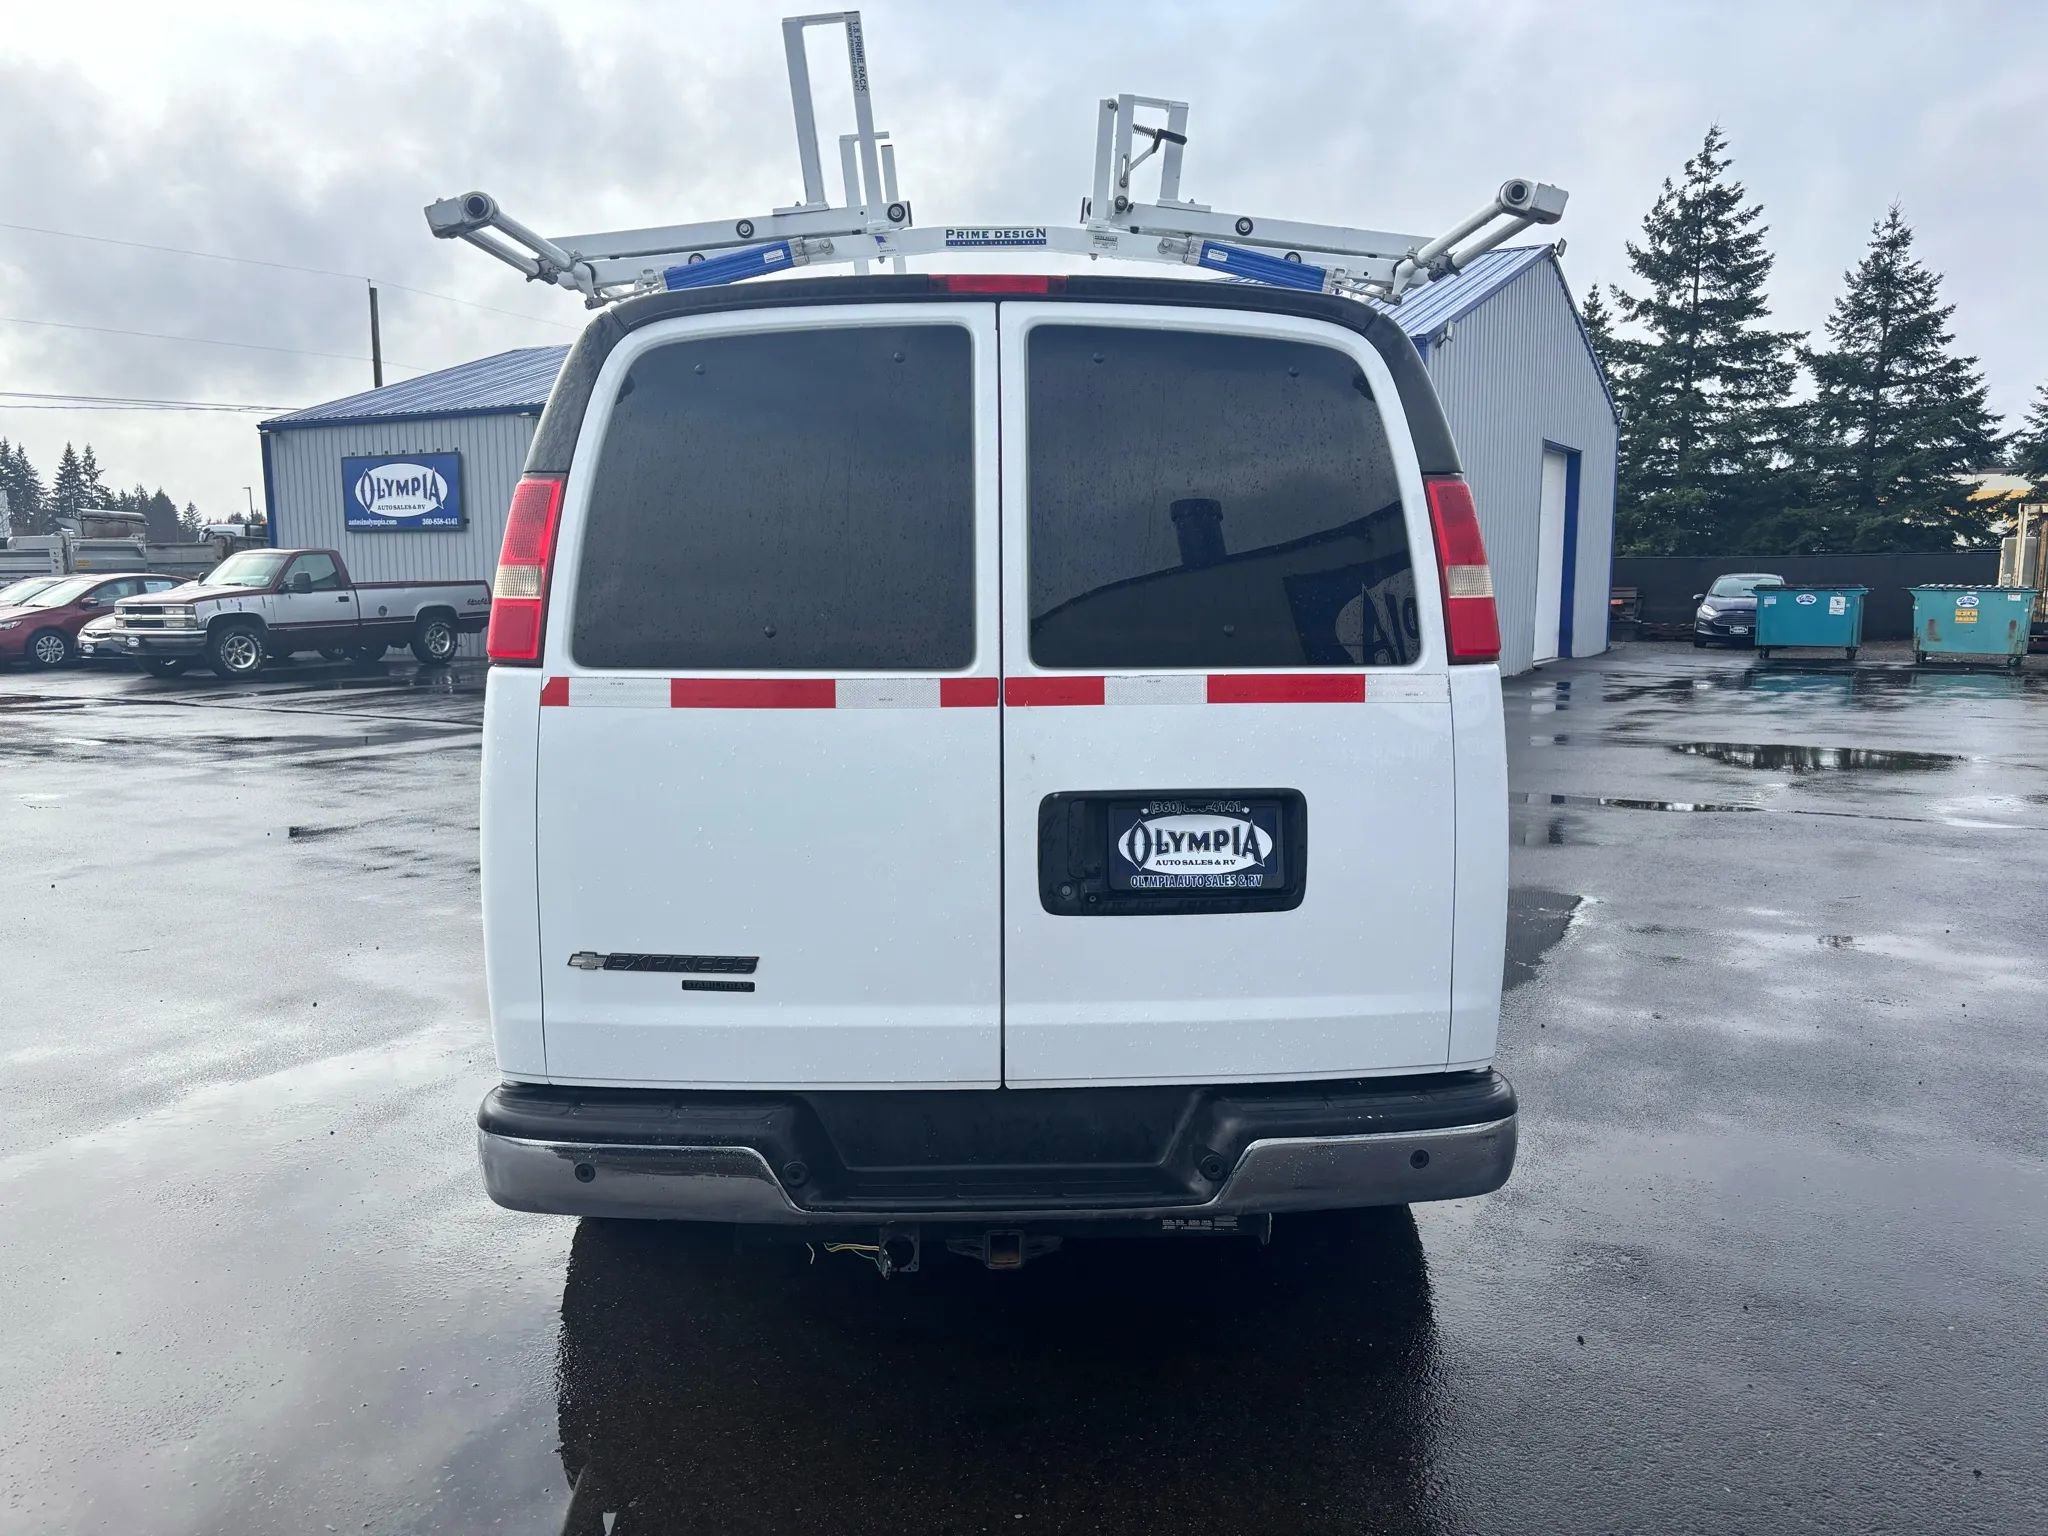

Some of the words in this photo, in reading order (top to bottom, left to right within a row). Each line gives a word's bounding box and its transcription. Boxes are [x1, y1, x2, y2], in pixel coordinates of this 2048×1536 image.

[945, 229, 989, 239] PRIME
[995, 228, 1047, 239] DESIGN
[360, 466, 445, 514] OLYMPIA
[1149, 801, 1182, 815] (360)
[1126, 818, 1265, 873] OLYMPIA
[1130, 874, 1176, 888] OLYMPIA
[1177, 874, 1206, 888] AUTO
[1206, 874, 1236, 887] SALES
[1237, 874, 1247, 886] &
[1247, 873, 1264, 886] RV
[604, 952, 760, 974] EXPRESS
